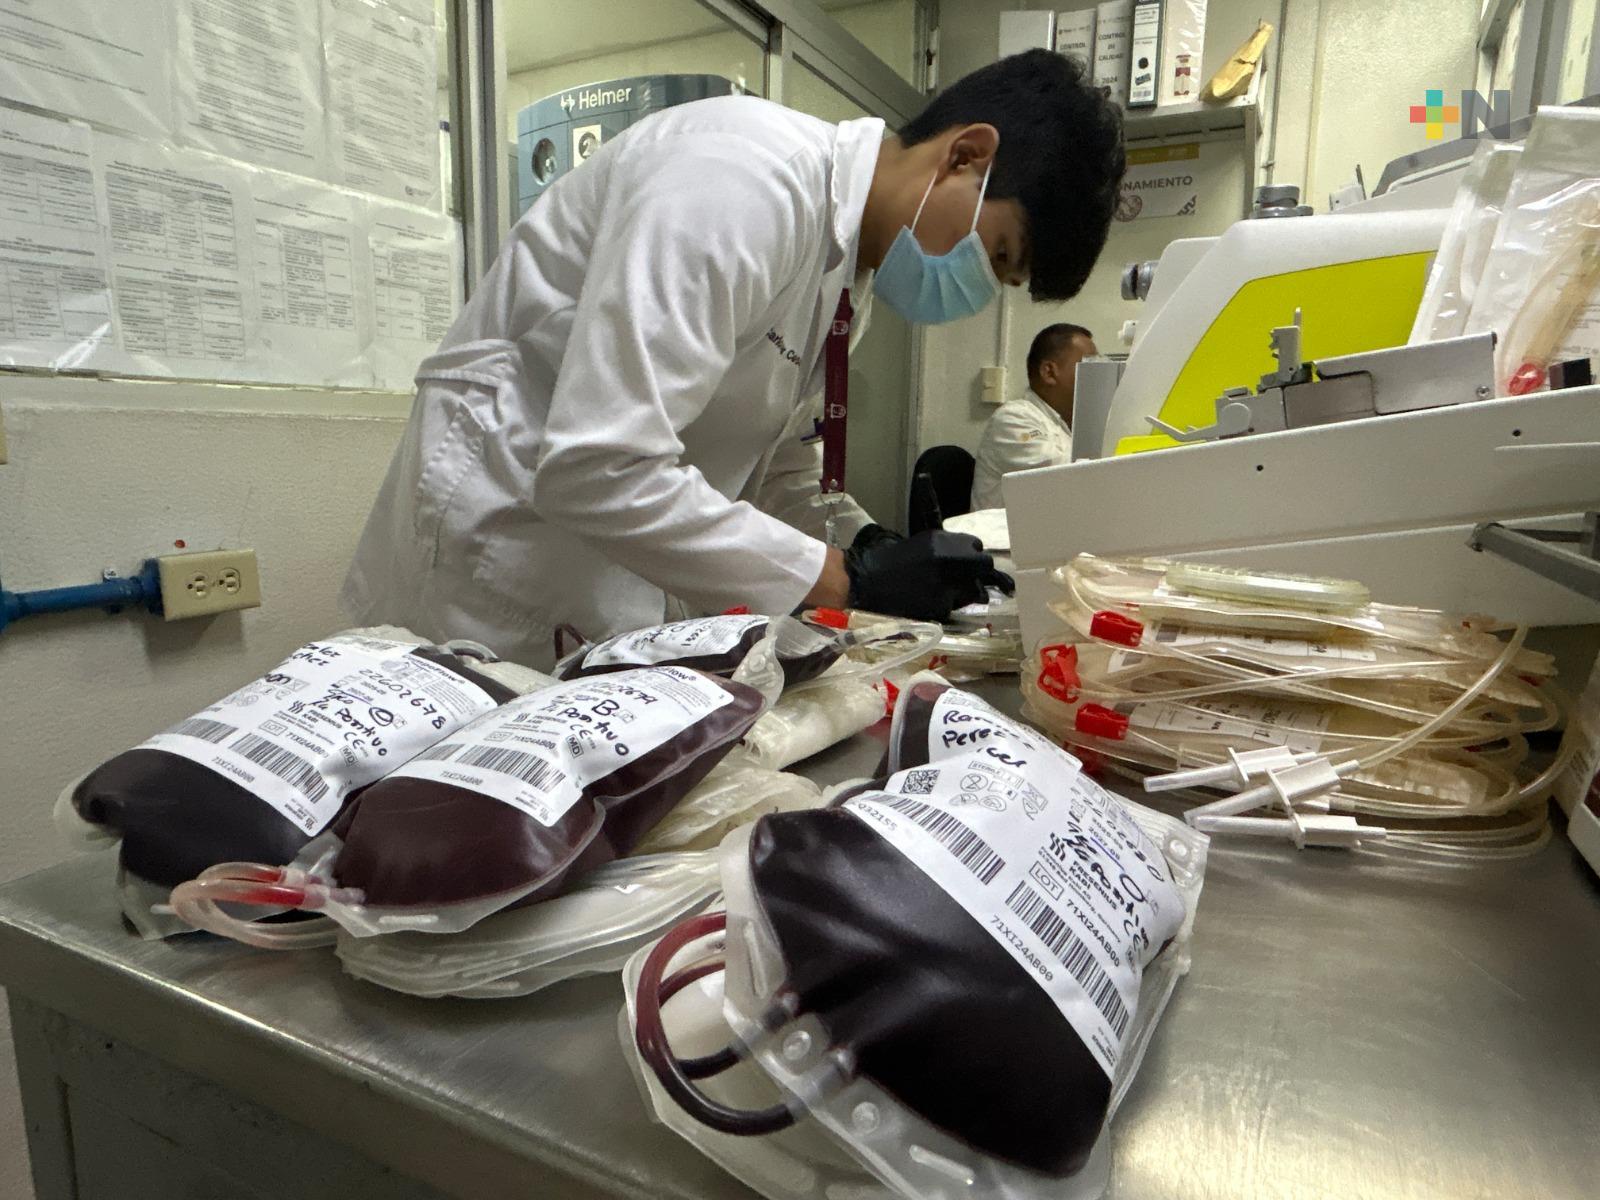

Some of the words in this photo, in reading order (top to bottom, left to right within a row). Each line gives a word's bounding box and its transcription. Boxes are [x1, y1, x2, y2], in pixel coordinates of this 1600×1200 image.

[1060, 42, 1086, 50] CONTROL
[1099, 32, 1126, 40] CONTROL
[579, 87, 633, 110] Helmer
[1122, 175, 1193, 192] NAMIENTO
[1069, 866, 1091, 890] KABI
[1073, 861, 1117, 911] FRESENIUS
[1066, 899, 1120, 967] 71XI24AB00
[989, 914, 1054, 982] 71XI24AB00
